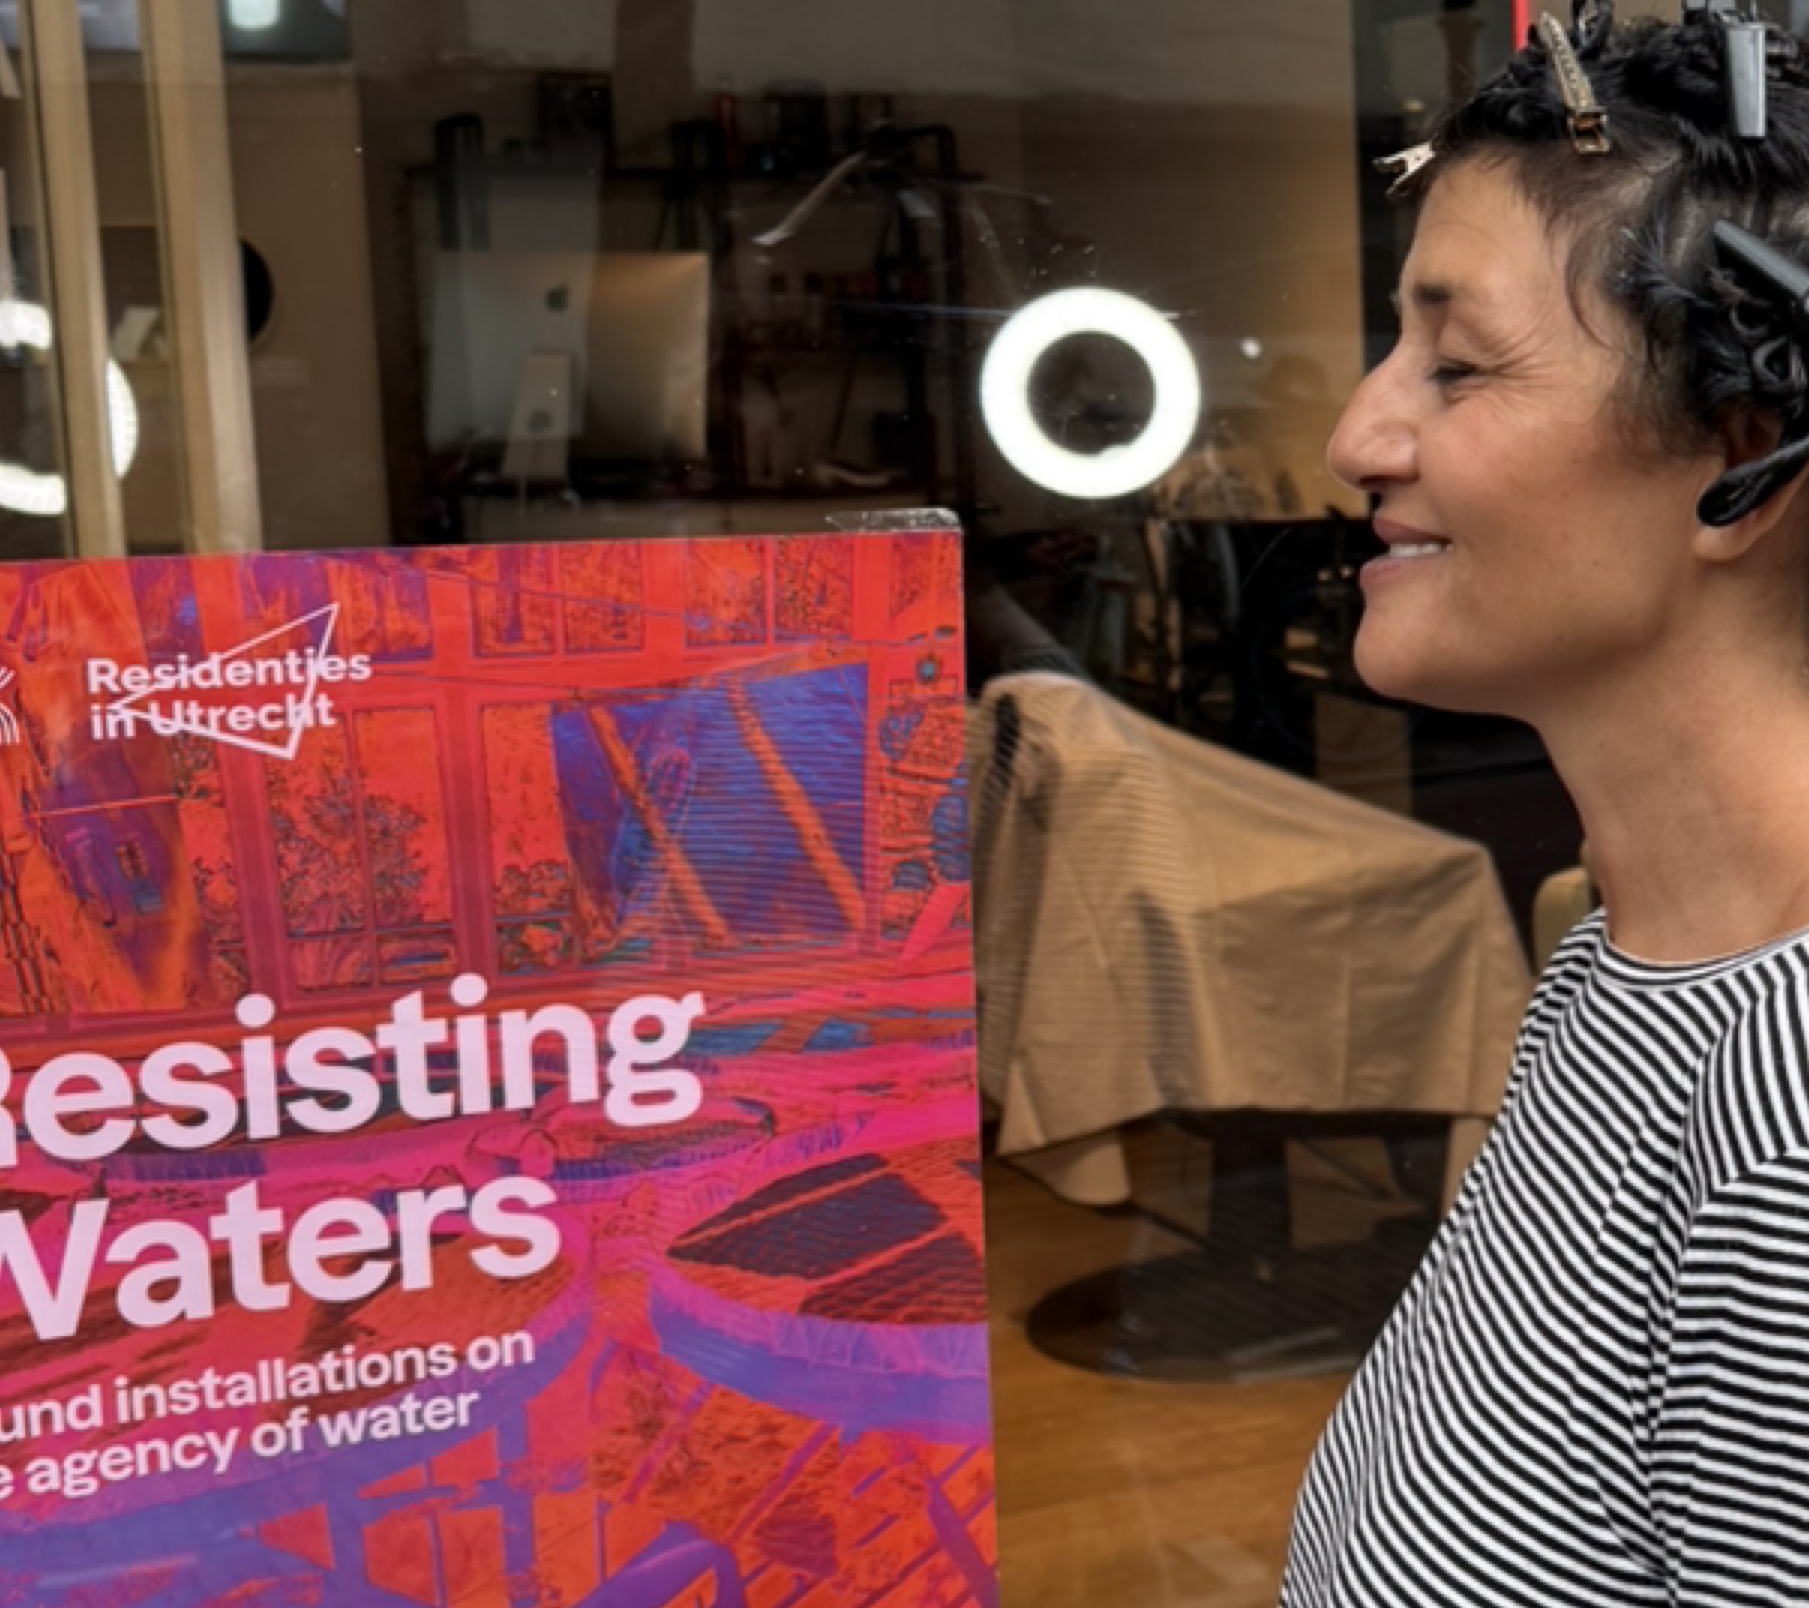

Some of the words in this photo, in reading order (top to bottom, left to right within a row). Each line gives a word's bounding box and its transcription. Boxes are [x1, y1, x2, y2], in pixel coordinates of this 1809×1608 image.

[87, 647, 372, 693] Residenties
[91, 702, 136, 740] in
[149, 693, 337, 736] Utrecht
[0, 972, 704, 1168] esisting
[114, 1341, 459, 1423] installations
[466, 1330, 536, 1372] on
[25, 1427, 240, 1498] agency
[252, 1404, 310, 1457] of
[317, 1391, 481, 1447] water
